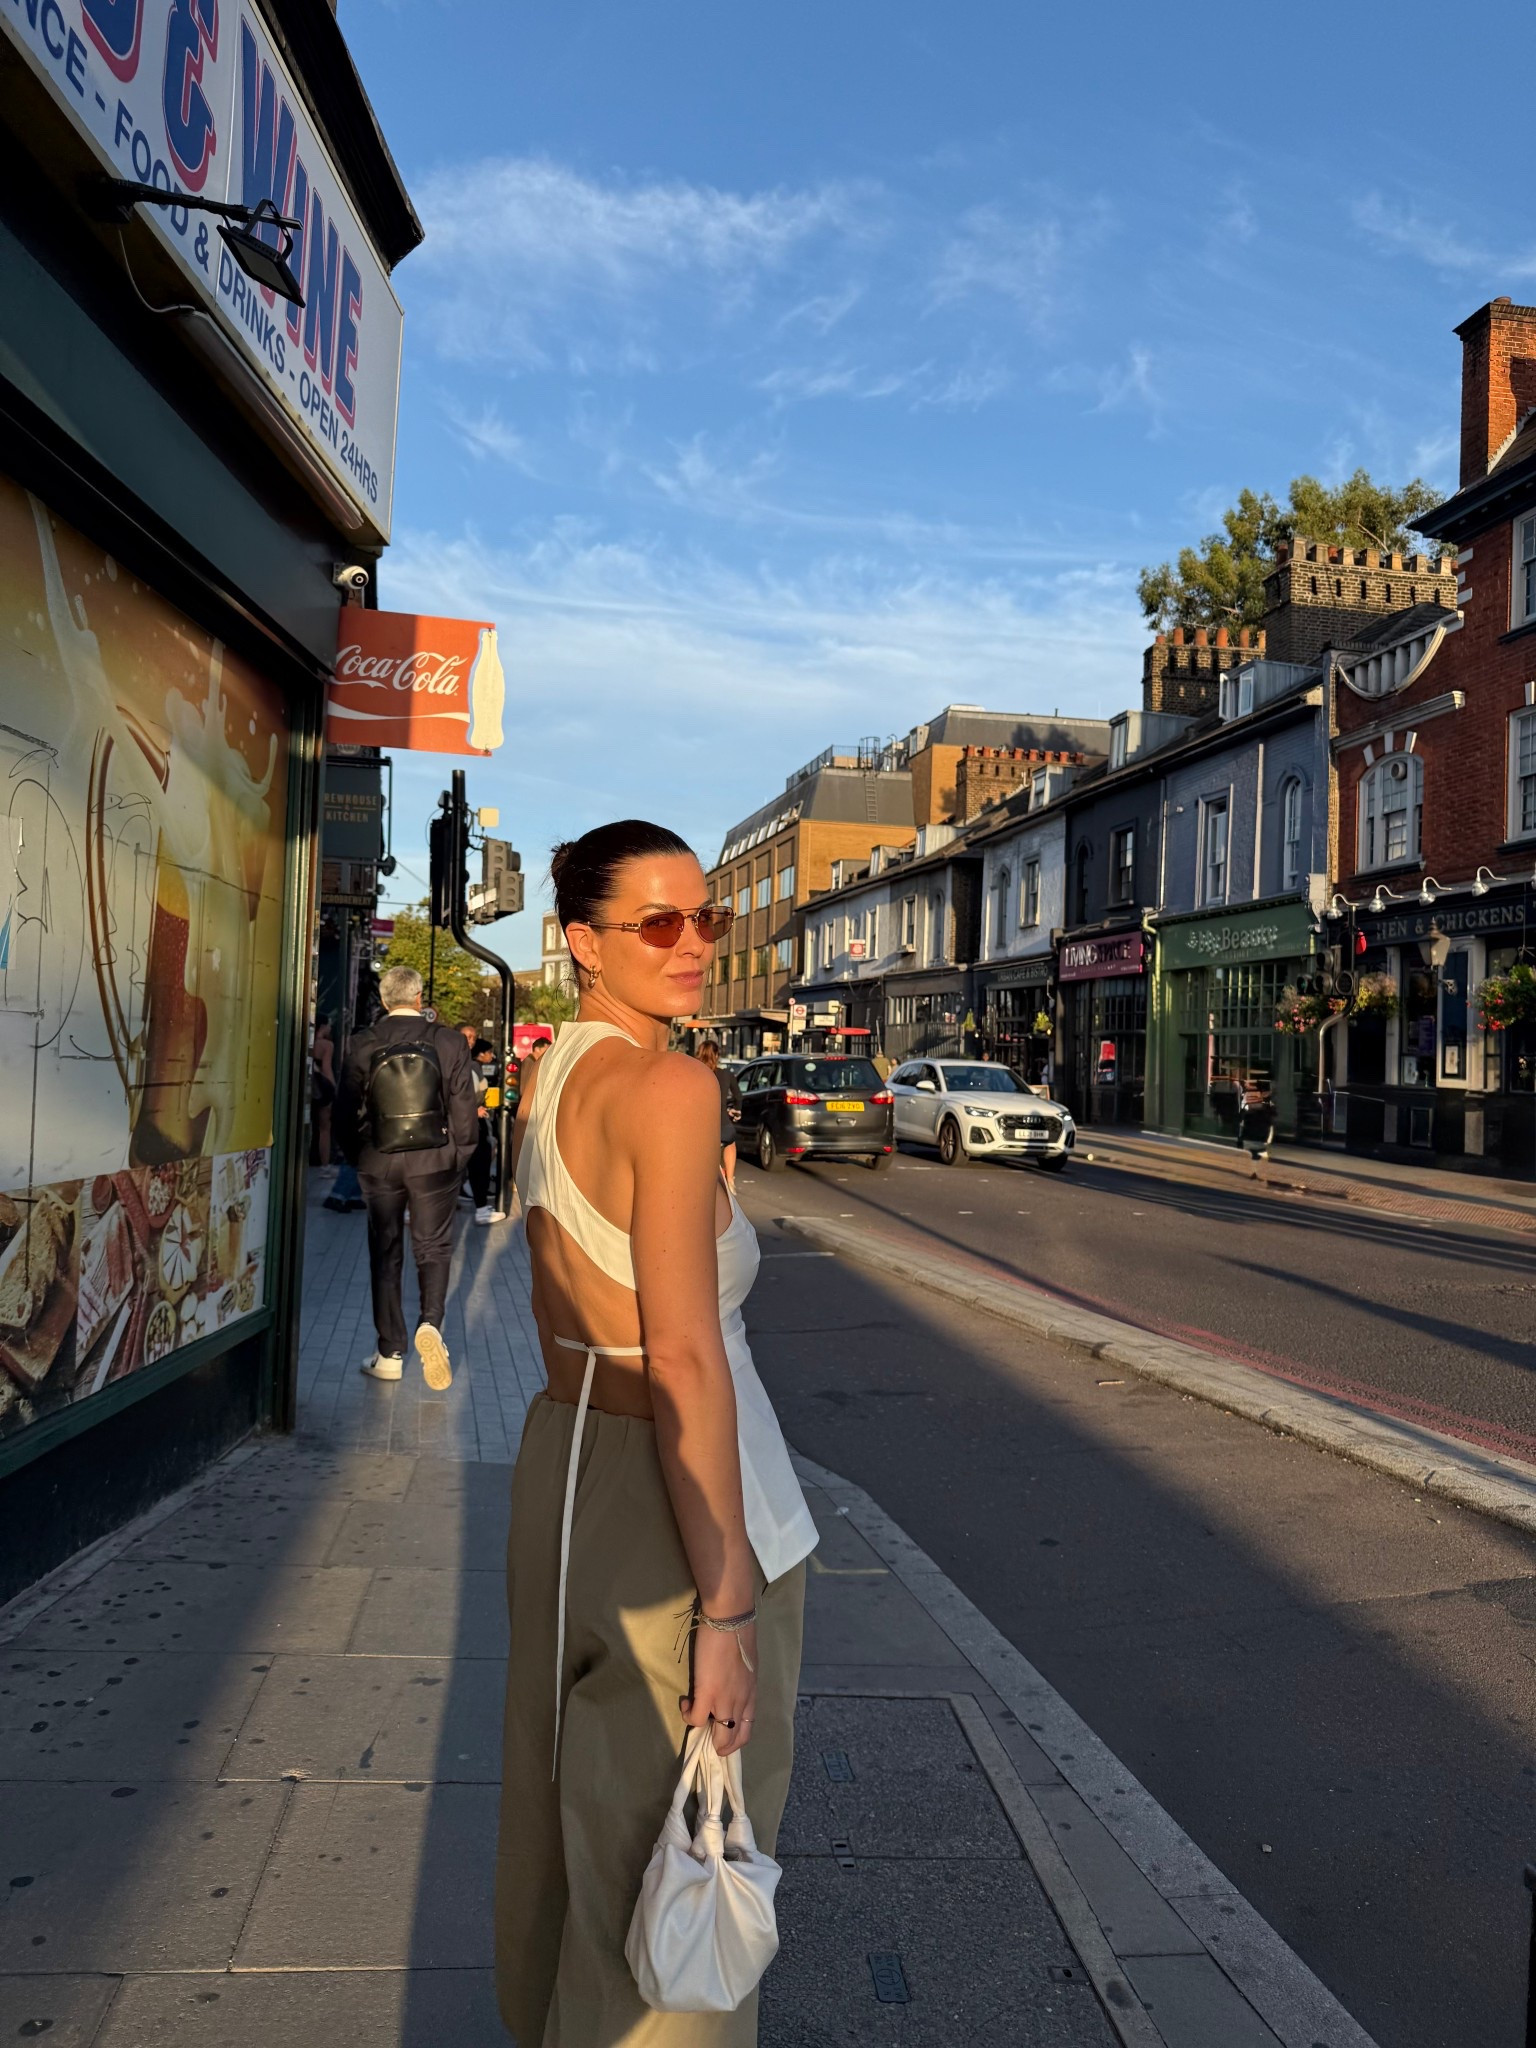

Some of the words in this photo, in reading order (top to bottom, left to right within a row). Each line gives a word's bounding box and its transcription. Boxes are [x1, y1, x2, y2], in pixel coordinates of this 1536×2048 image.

[241, 14, 362, 430] WINE
[115, 98, 189, 237] FOOD
[194, 221, 210, 274] &
[219, 245, 285, 374] DRINKS
[299, 371, 338, 449] OPEN
[341, 431, 379, 505] 24HRS
[325, 811, 369, 823] KITCHEN
[1221, 924, 1278, 951] Beauty
[1376, 919, 1408, 941] HEN
[1415, 918, 1424, 935] &
[1434, 904, 1525, 932] CHICKENS
[1064, 944, 1097, 968] LIVING
